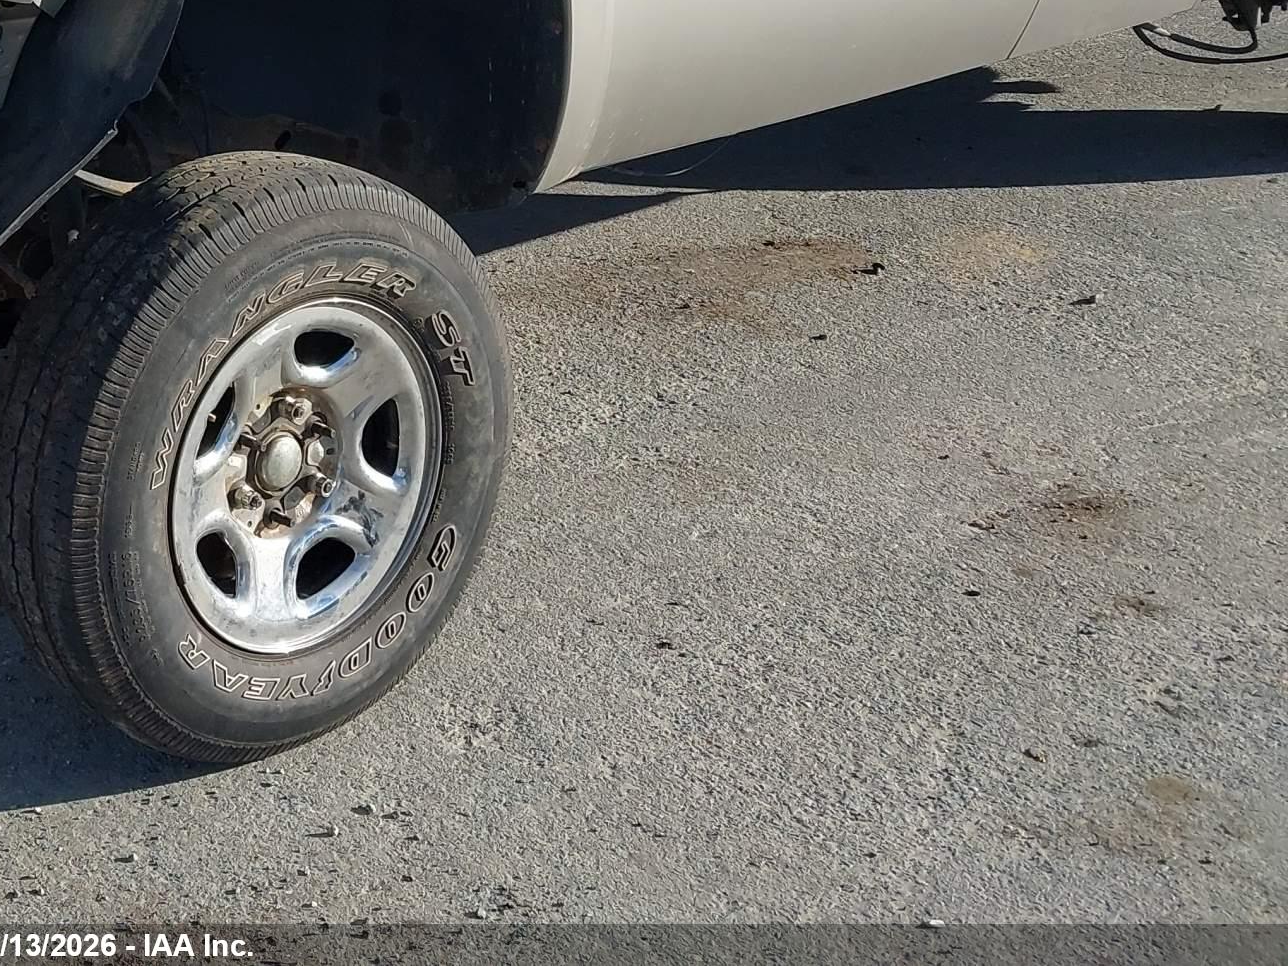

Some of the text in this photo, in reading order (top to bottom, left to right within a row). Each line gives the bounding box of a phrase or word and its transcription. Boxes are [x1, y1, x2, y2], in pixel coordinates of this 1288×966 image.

[149, 261, 476, 491] WRANGLER ST
[177, 524, 458, 702] GOODYEAR
